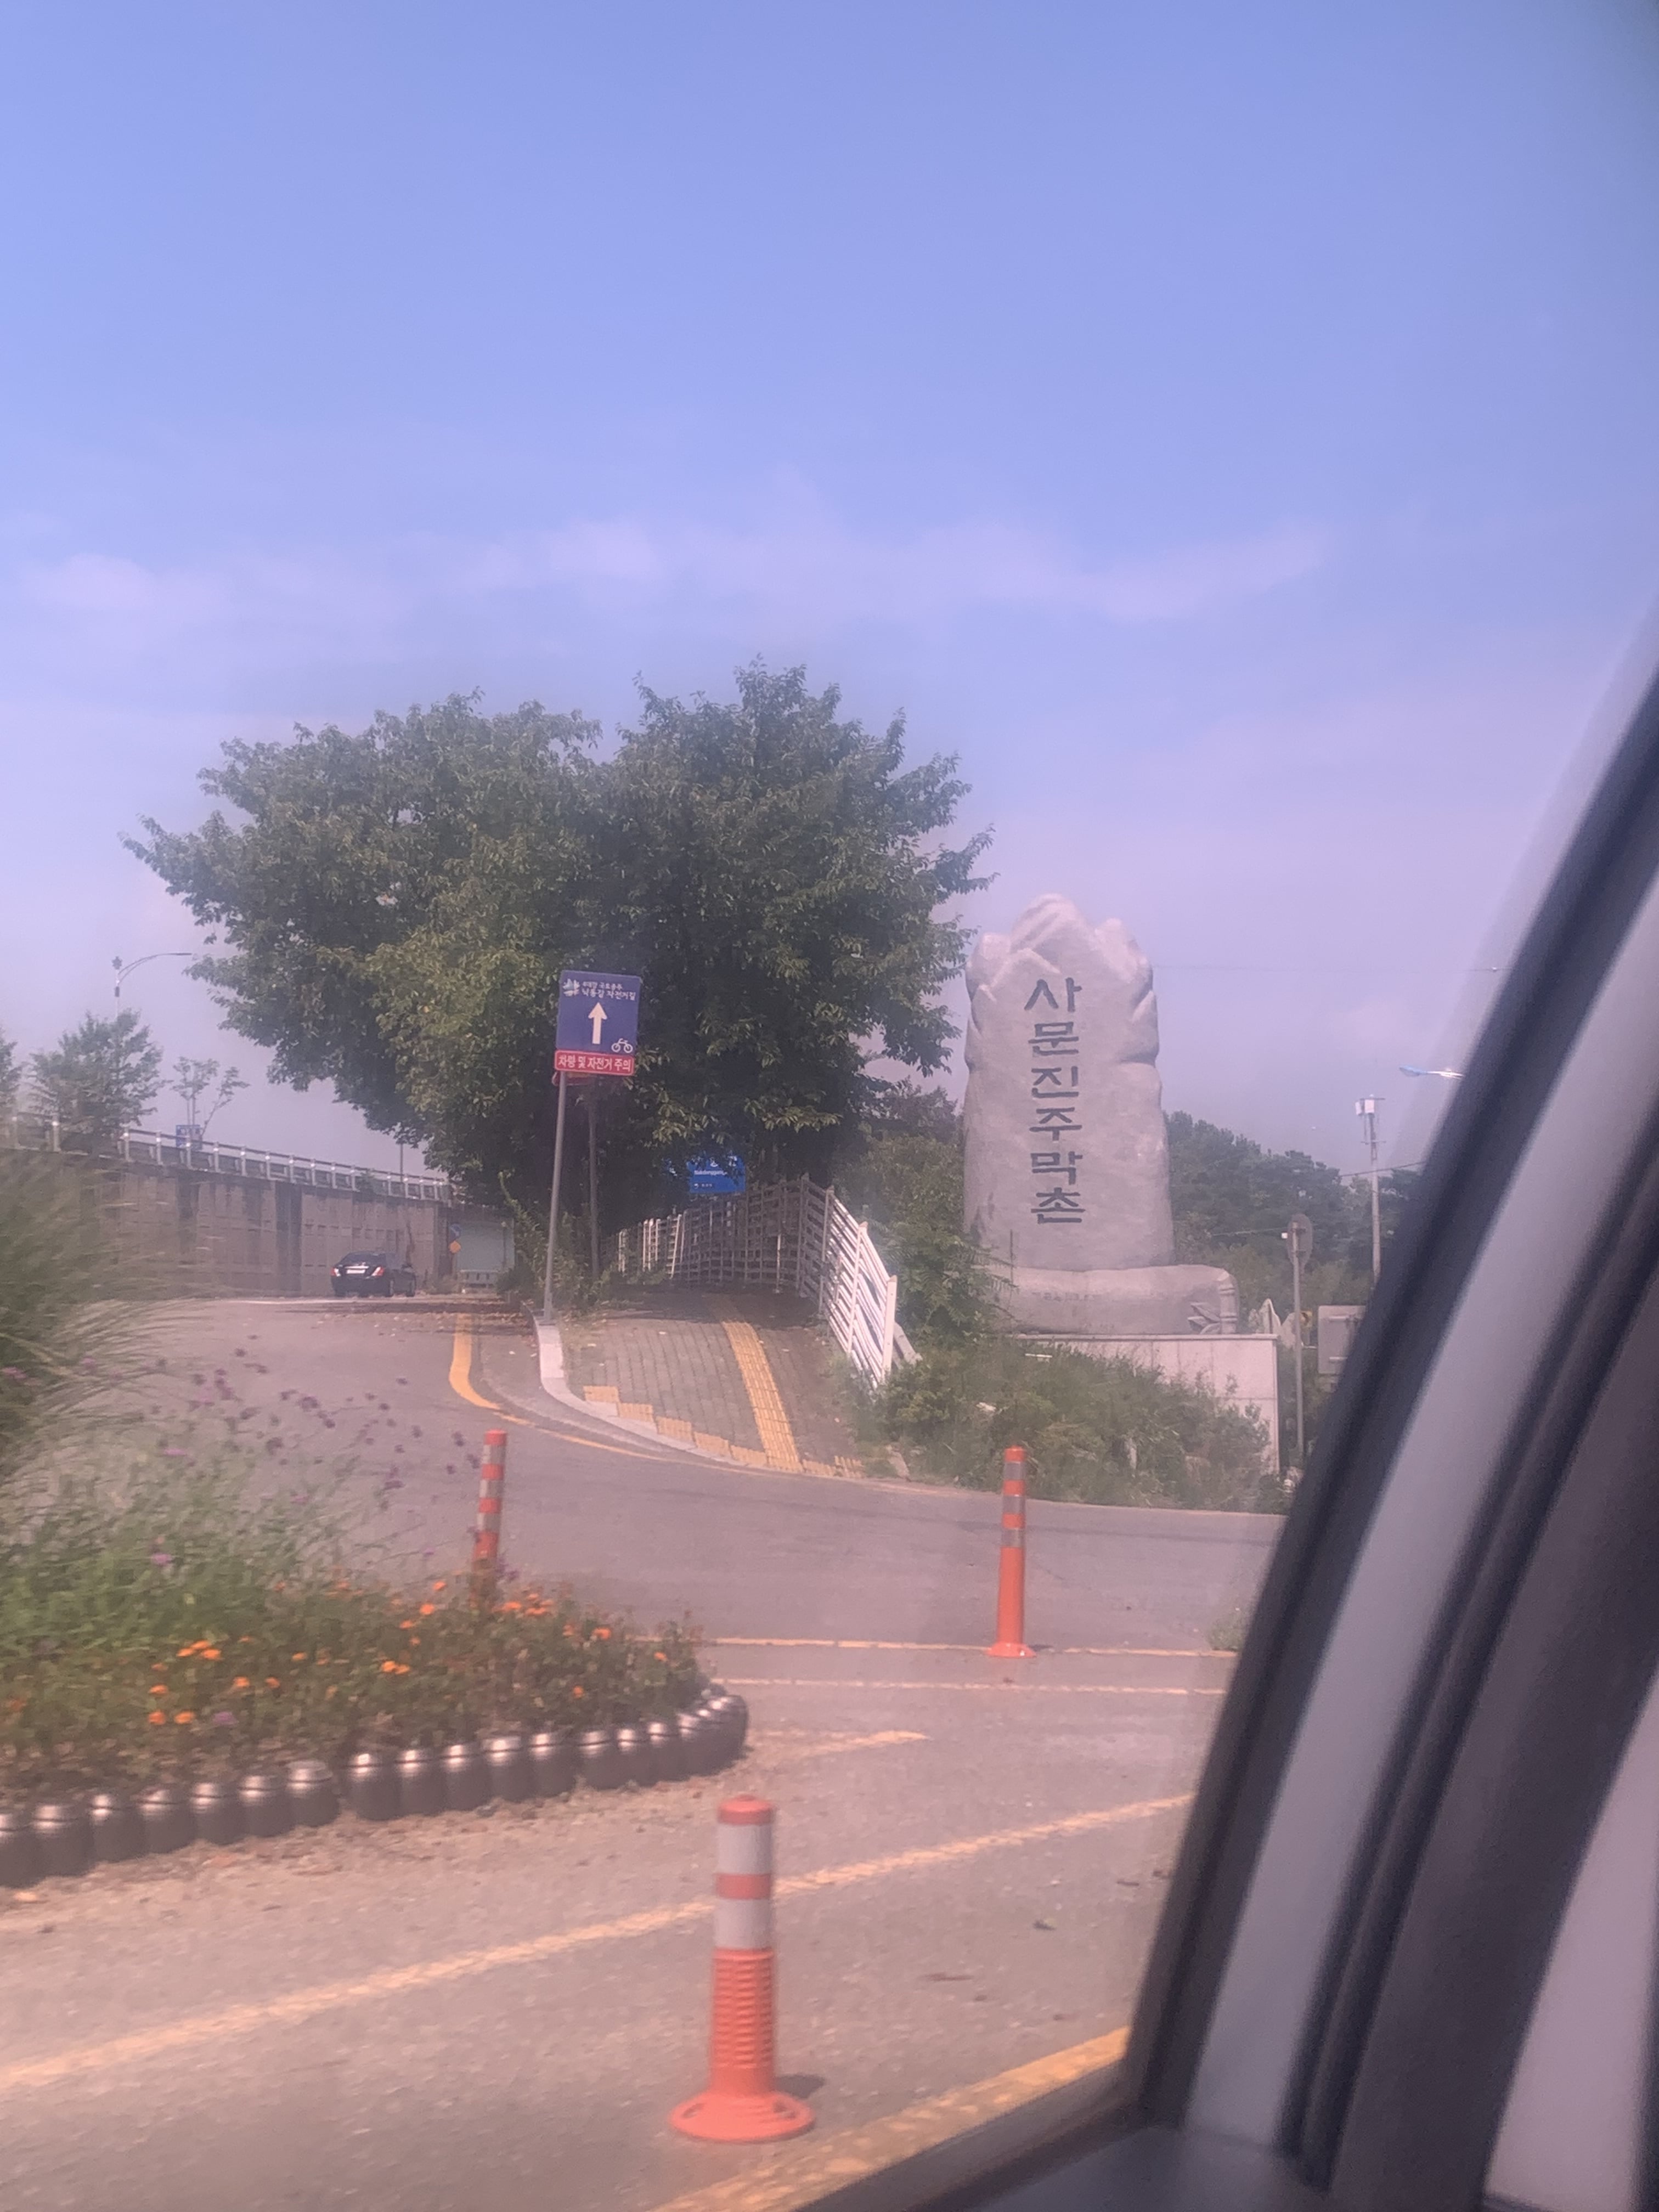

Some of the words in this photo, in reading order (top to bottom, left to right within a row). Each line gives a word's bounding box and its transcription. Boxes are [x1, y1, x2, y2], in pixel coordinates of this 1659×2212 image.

[558, 1055, 575, 1068] 차량
[578, 1056, 586, 1068] 및
[587, 1057, 612, 1071] 자전거
[614, 1058, 631, 1072] 주의
[1024, 977, 1086, 1224] 사문진주막촌
